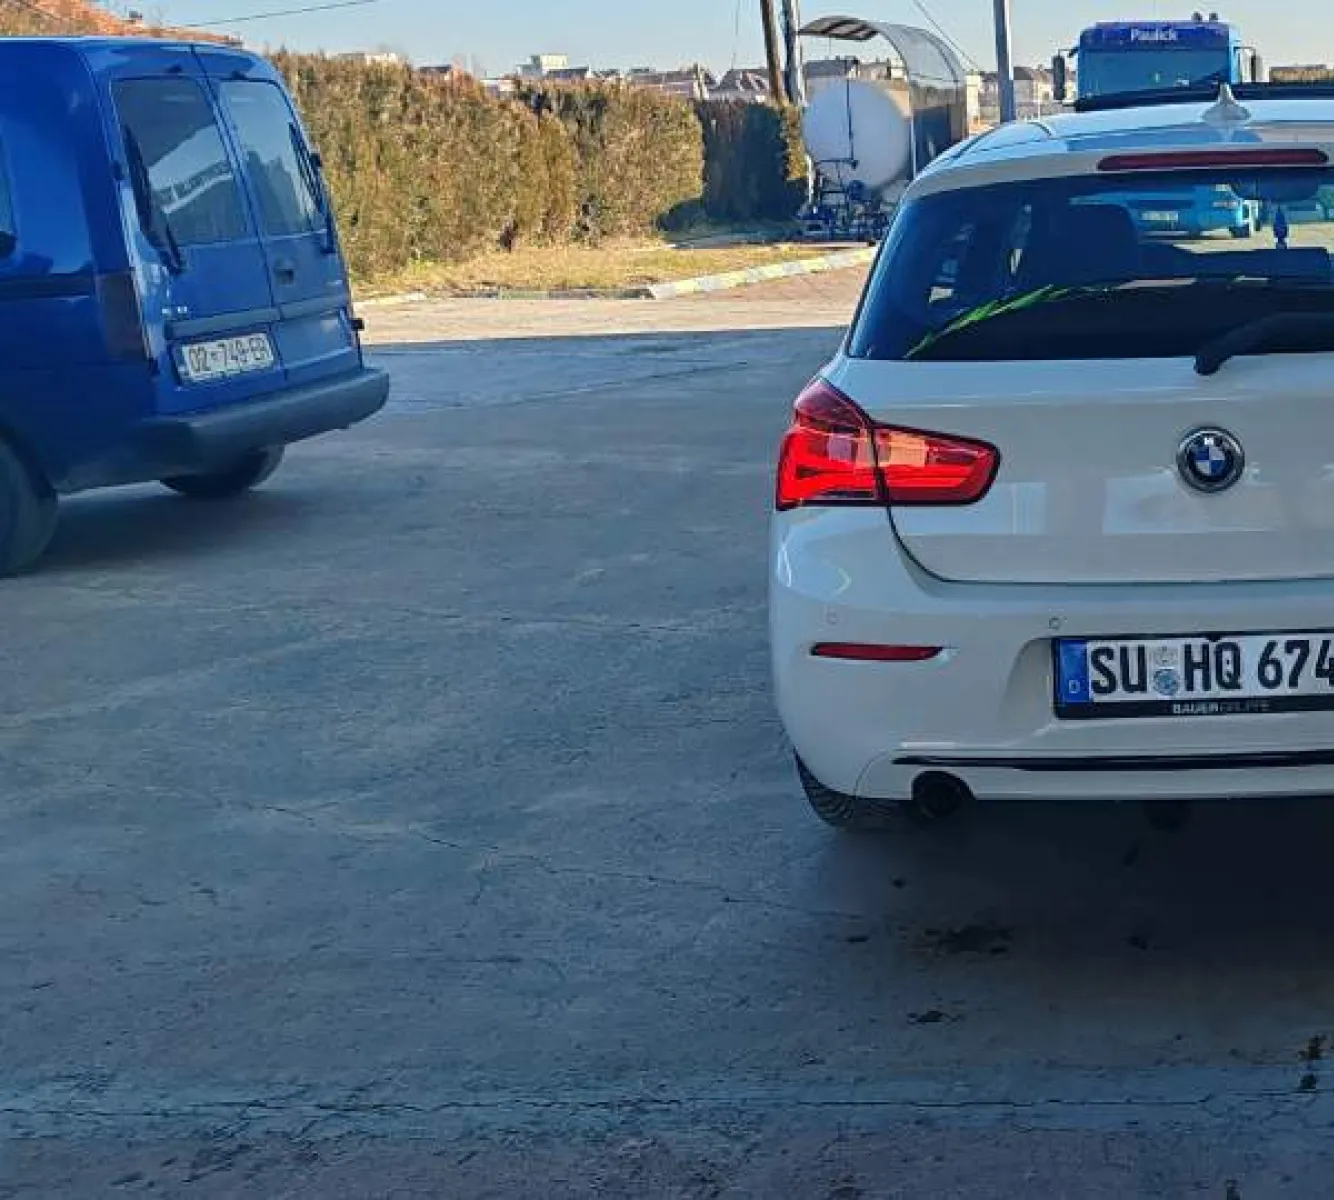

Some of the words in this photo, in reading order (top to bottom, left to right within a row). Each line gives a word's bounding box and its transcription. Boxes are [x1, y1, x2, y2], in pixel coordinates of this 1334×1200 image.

[1130, 27, 1178, 41] Paulick
[1090, 644, 1148, 694] SU
[1184, 642, 1242, 691] HQ
